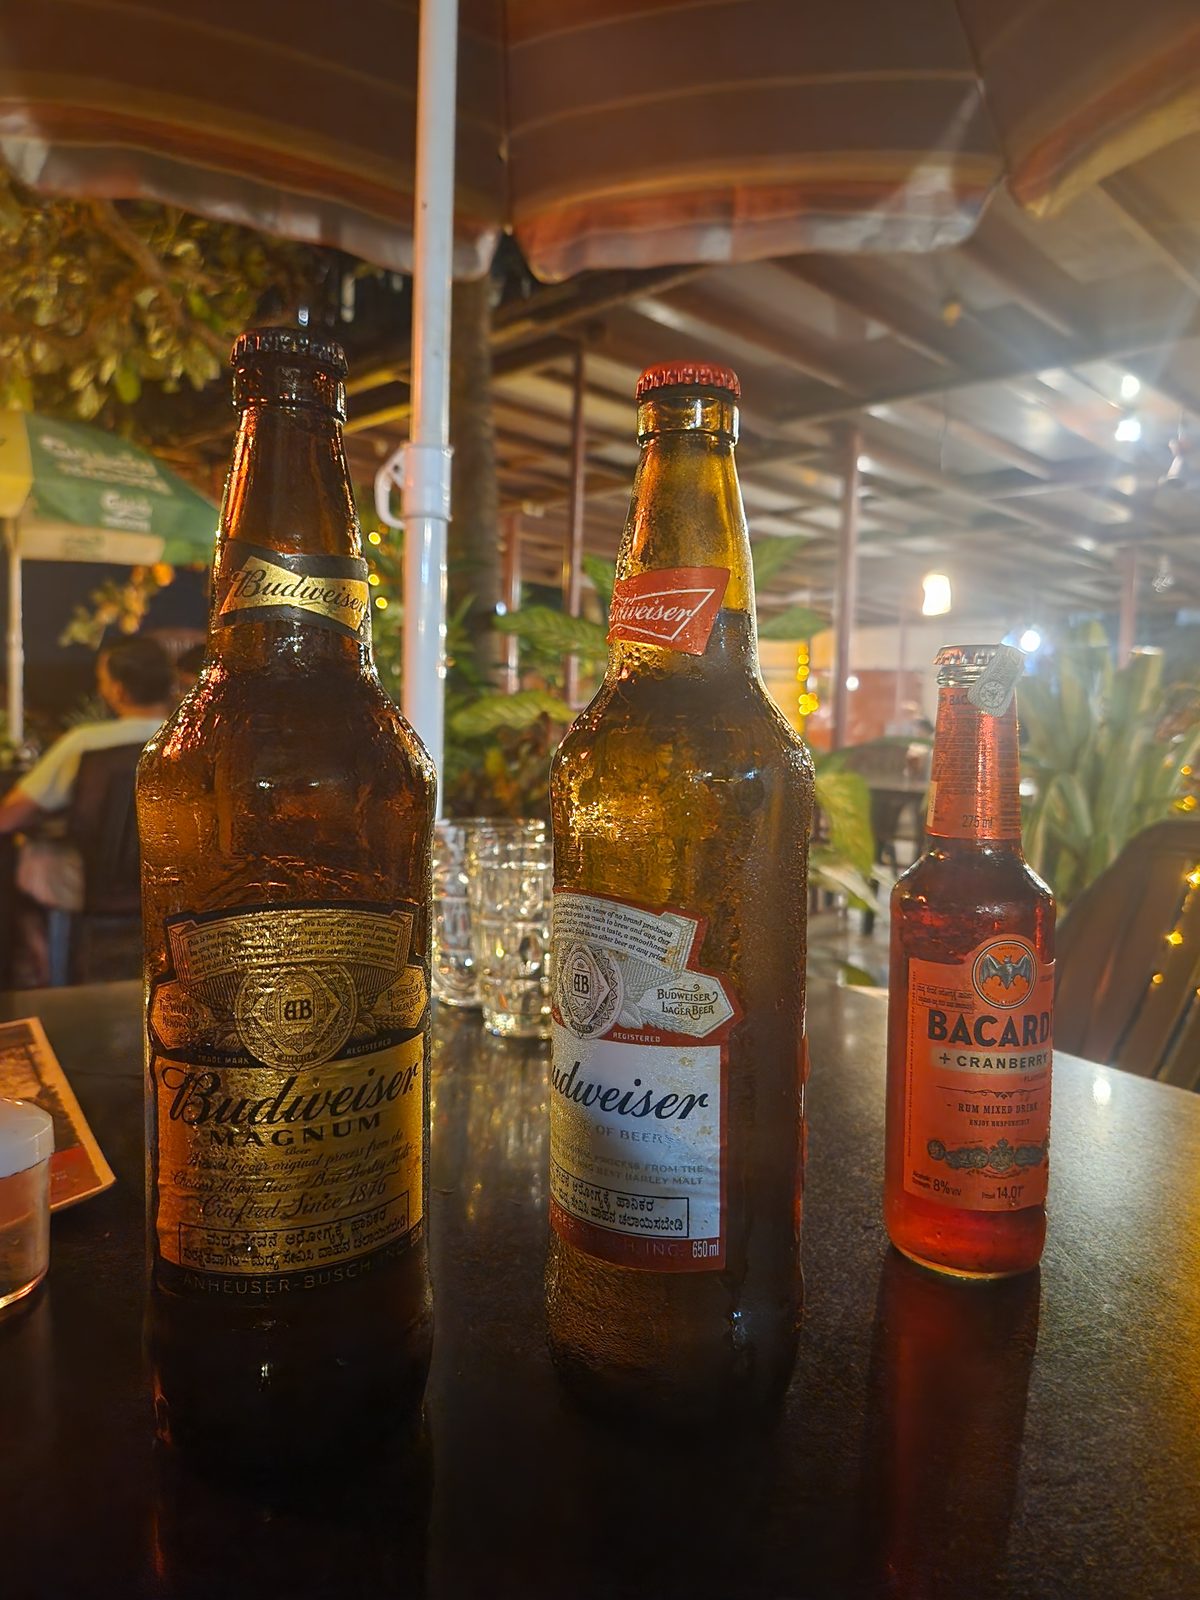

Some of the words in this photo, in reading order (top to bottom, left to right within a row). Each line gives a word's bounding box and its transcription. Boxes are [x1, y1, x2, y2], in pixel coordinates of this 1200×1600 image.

[231, 569, 367, 612] Budweiser
[962, 815, 979, 828] 275
[642, 922, 673, 938] produced
[657, 988, 711, 1002] BUDWEISER
[612, 1031, 661, 1043] REGISTERED
[928, 1009, 1050, 1048] BACARD
[161, 1061, 419, 1126] Budweiser
[550, 1060, 709, 1120] udweiser
[958, 1103, 979, 1113] RUM
[983, 1104, 1013, 1115] MIXED
[210, 1111, 381, 1148] MAGNUM
[273, 1152, 323, 1177] original
[680, 1164, 704, 1174] THE
[692, 1241, 708, 1259] 650
[708, 1240, 720, 1258] ml
